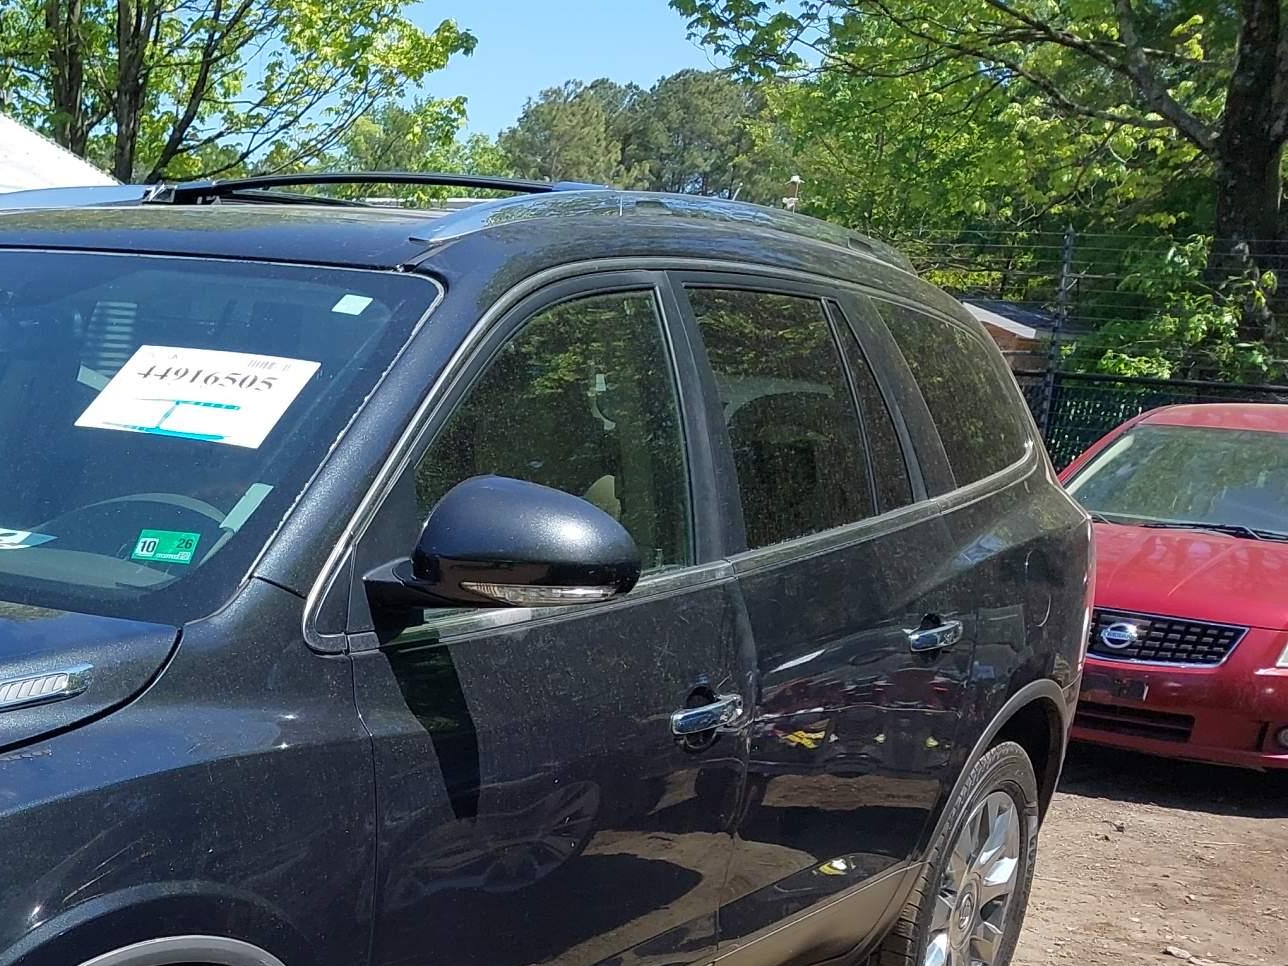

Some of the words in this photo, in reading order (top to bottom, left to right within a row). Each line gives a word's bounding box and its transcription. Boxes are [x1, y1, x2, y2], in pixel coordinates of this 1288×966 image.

[137, 365, 278, 391] 44916505
[140, 539, 157, 553] 10
[176, 538, 194, 550] 26
